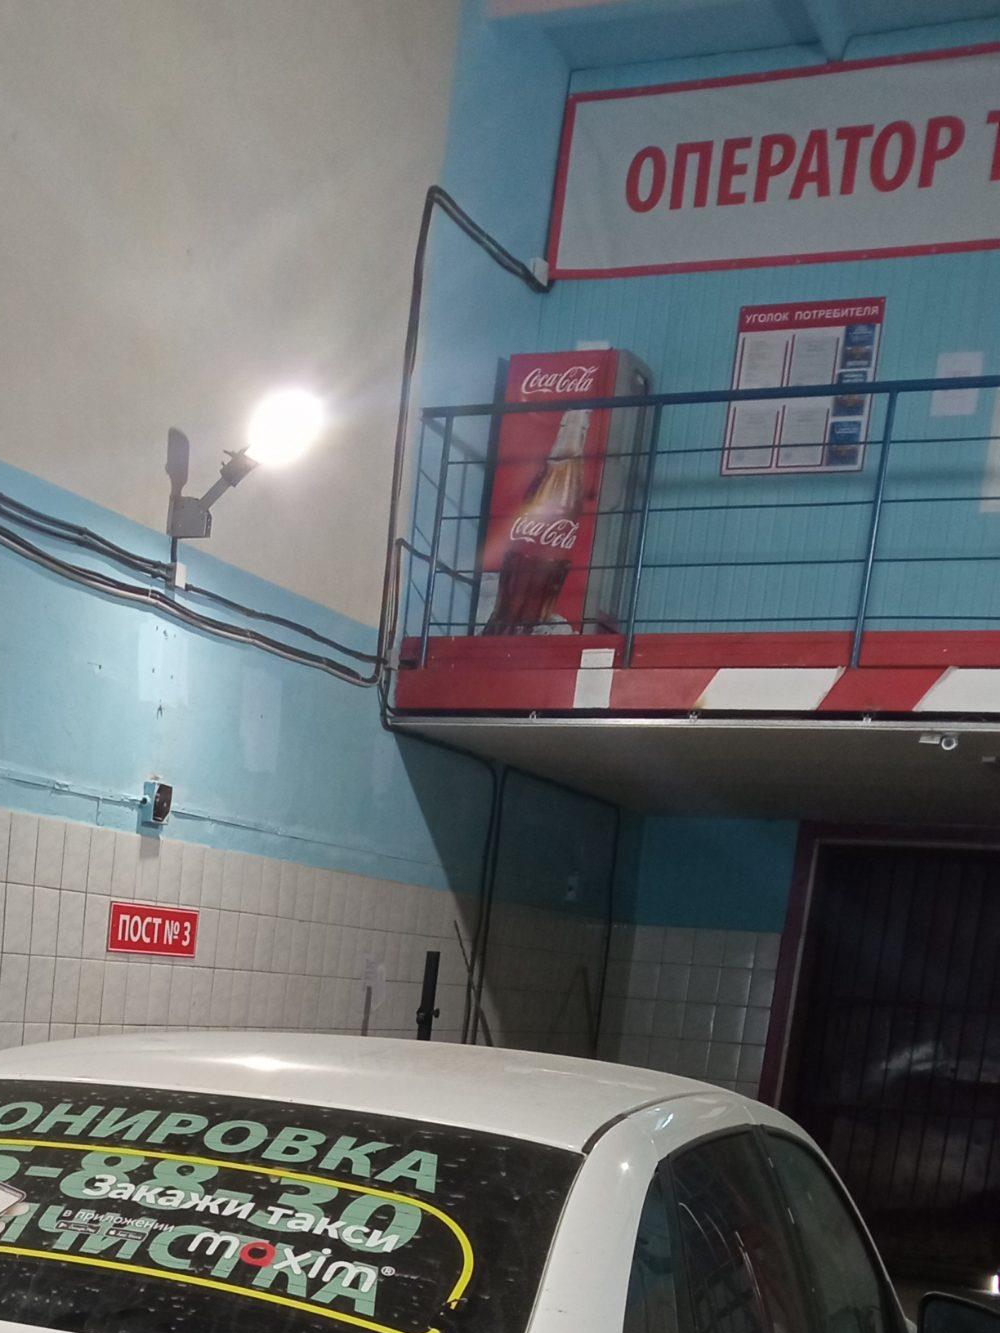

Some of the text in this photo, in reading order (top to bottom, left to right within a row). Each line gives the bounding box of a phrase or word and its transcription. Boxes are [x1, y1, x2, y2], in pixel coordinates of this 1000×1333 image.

[625, 114, 966, 213] ОПЕРАТОР
[745, 305, 880, 325] УГОЛОК ПОТРЕБИТЕЛЯ
[520, 365, 599, 395] Coca-Cola
[509, 513, 580, 550] Coca-Cola
[117, 913, 163, 944] ПОСТ
[62, 1209, 73, 1218] в
[74, 1211, 175, 1233] приложении
[81, 1174, 401, 1253] Закажи такси
